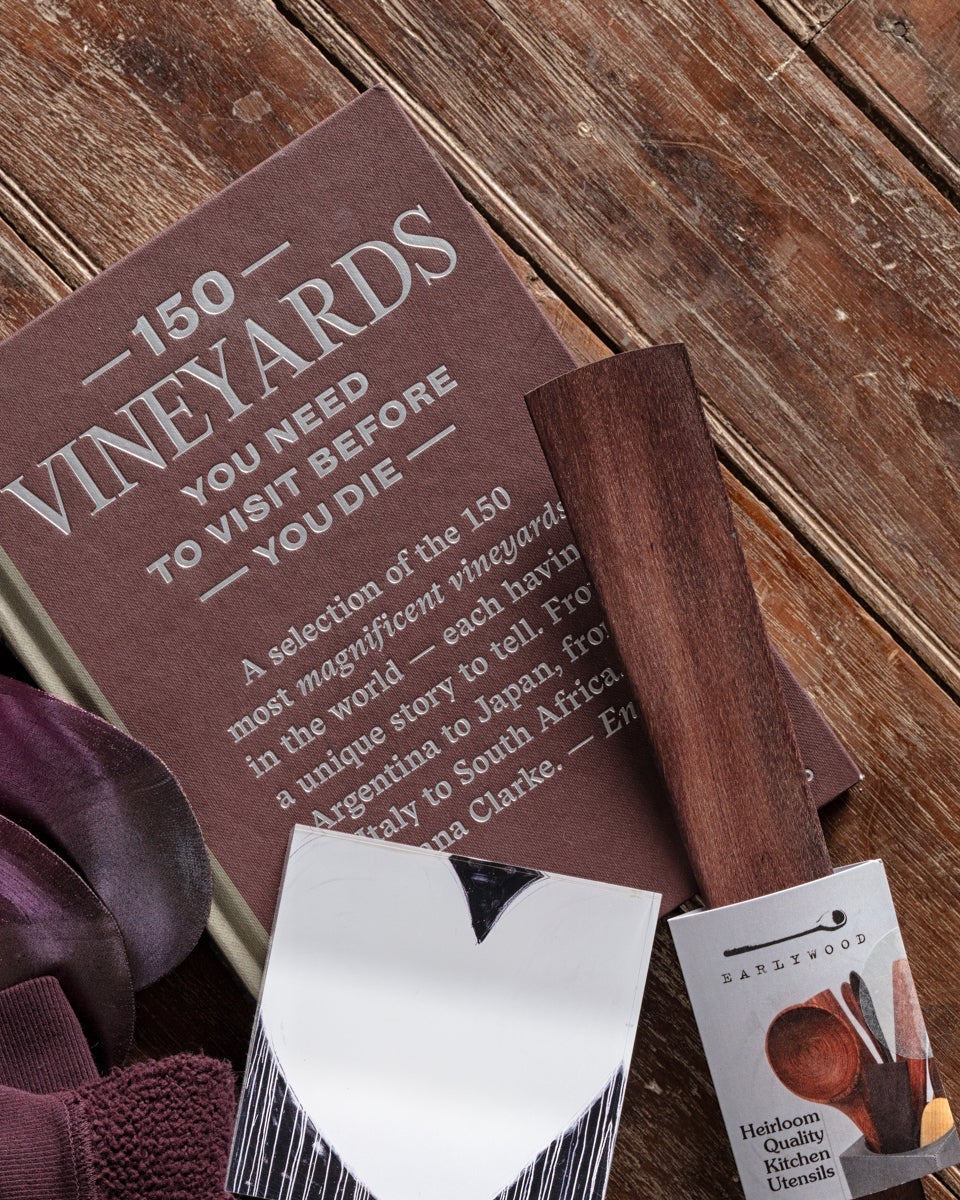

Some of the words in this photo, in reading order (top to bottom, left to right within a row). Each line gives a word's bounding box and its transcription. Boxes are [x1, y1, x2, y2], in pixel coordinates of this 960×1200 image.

[0, 205, 458, 535] VINEYARDS
[131, 270, 236, 356] 150
[146, 540, 202, 584] TO
[205, 467, 301, 544] VISIT
[307, 365, 458, 478] BEFORE
[180, 443, 261, 506] YOU
[264, 371, 369, 454] NEED
[252, 503, 333, 565] YOU
[333, 457, 403, 515] DIE
[242, 658, 267, 686] A
[268, 580, 383, 666] selection
[385, 548, 414, 585] of
[414, 526, 461, 562] the
[460, 486, 512, 532] 150
[227, 687, 294, 743] most
[296, 582, 445, 696] magnificent
[245, 749, 281, 778] in
[280, 717, 326, 754] the
[328, 659, 405, 720] world
[443, 596, 504, 645] each
[501, 543, 580, 603] havin
[276, 789, 296, 809] a
[296, 725, 386, 793] unique
[390, 676, 455, 731] story
[458, 656, 488, 682] to
[490, 618, 544, 661] tell.
[541, 582, 592, 625] Fro
[311, 740, 442, 829] Argentina
[441, 717, 471, 744] to
[474, 661, 563, 723] Japan,
[562, 622, 610, 663] fro
[422, 780, 452, 806] to
[453, 724, 534, 785] South
[468, 759, 563, 823] Clarke.
[598, 701, 638, 738] En
[722, 933, 867, 984] EARLYWOOD
[740, 1111, 821, 1140] Heirloom
[763, 1129, 825, 1154] Quality
[763, 1149, 831, 1175] Kitchen
[767, 1165, 836, 1193] Utensils
